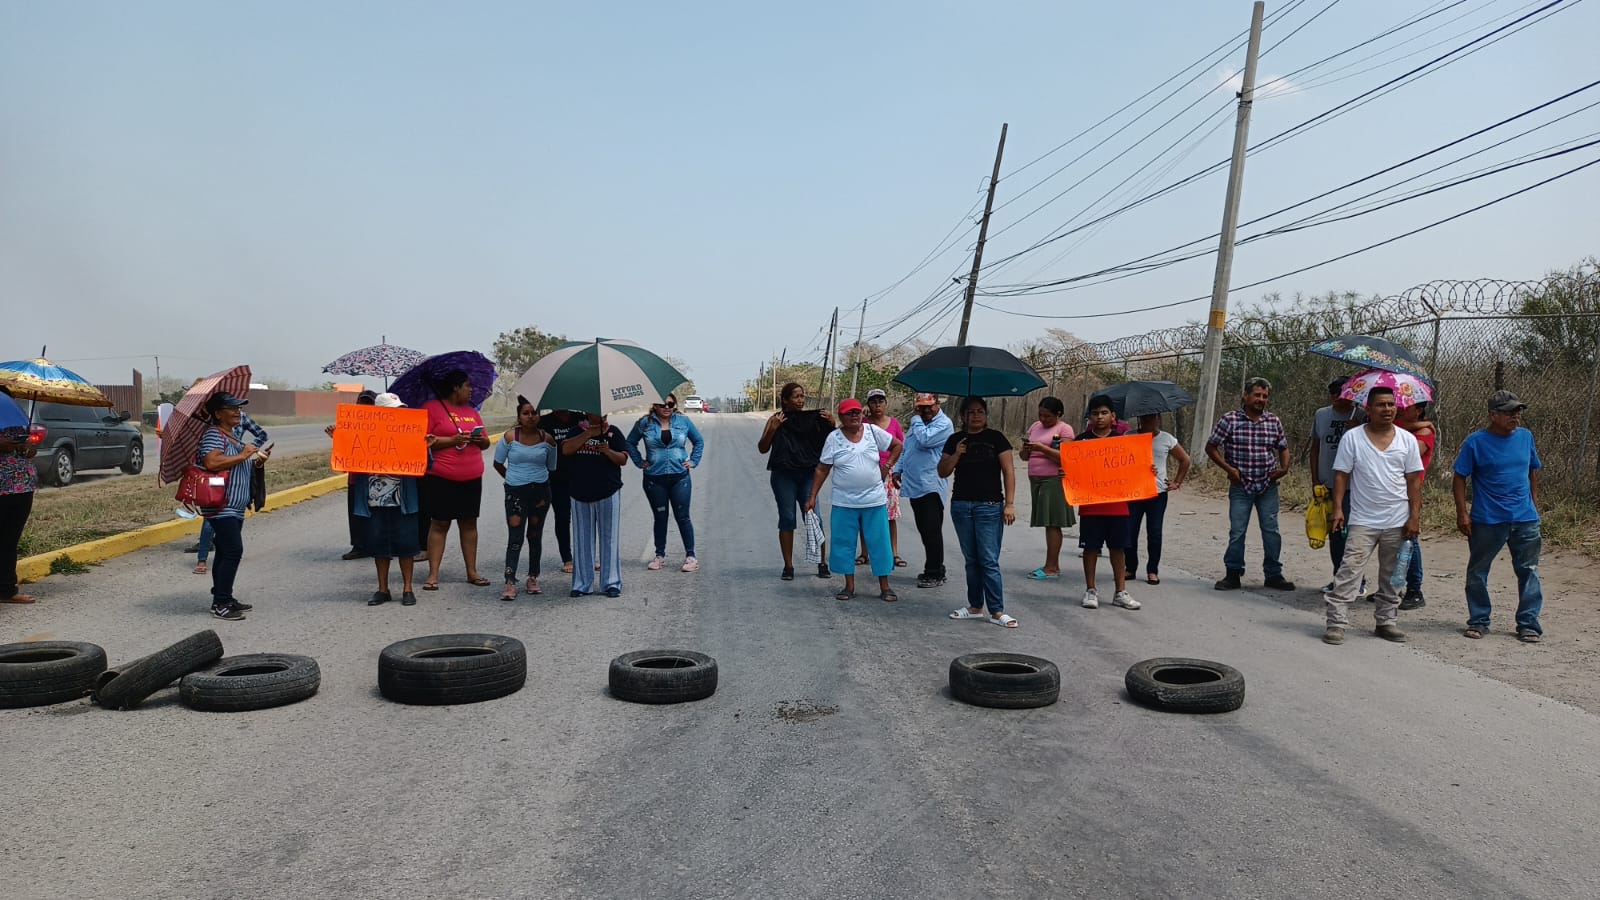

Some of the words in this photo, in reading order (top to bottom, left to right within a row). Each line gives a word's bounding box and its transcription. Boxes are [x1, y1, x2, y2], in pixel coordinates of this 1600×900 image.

[611, 384, 642, 395] LYFORD
[351, 433, 398, 456] AGUA
[1103, 453, 1136, 469] AGUA
